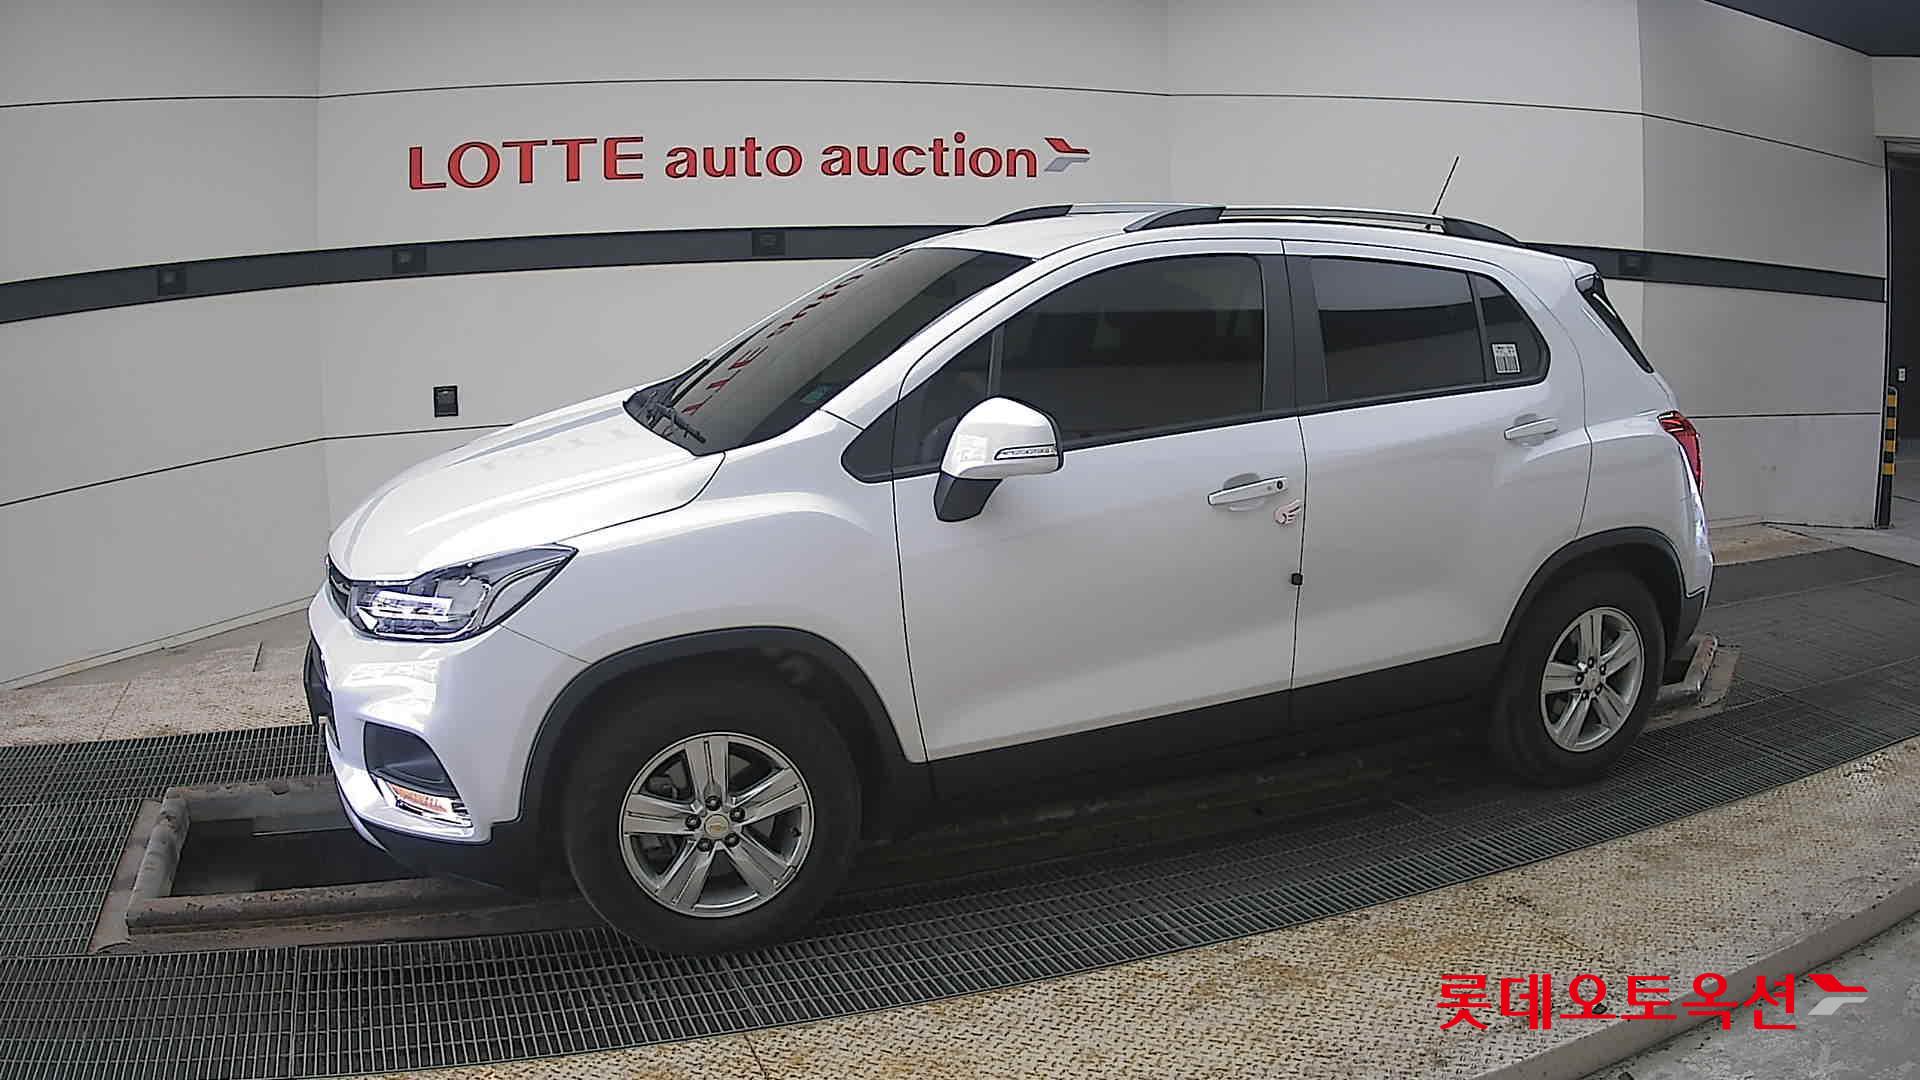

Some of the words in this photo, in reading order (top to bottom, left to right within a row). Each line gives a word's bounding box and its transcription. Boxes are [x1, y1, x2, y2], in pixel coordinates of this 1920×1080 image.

[408, 136, 645, 190] LOTTE
[664, 136, 804, 179] auto
[820, 132, 1038, 179] auction
